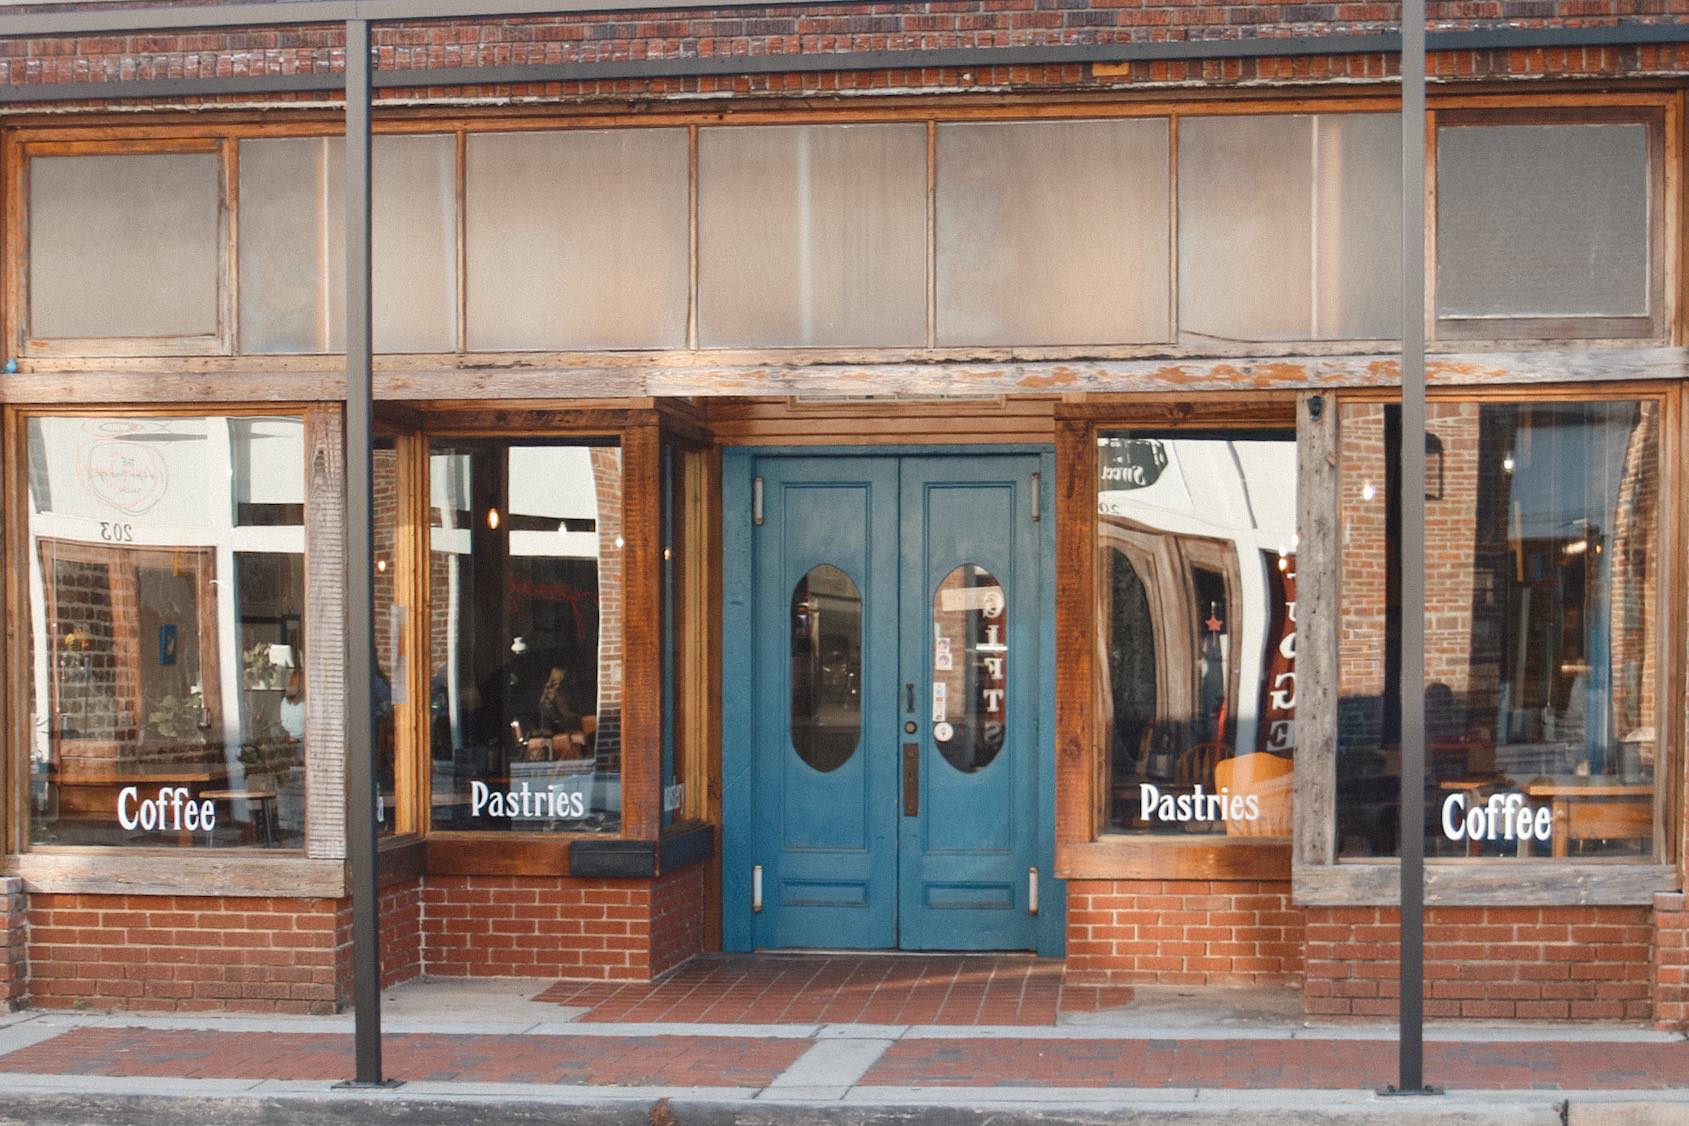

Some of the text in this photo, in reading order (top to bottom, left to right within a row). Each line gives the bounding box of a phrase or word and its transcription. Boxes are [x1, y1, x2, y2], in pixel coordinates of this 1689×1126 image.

[117, 786, 216, 831] Coffee
[470, 780, 584, 818] Pastries
[1139, 783, 1260, 821] Pastries
[1441, 793, 1552, 841] Coffee
